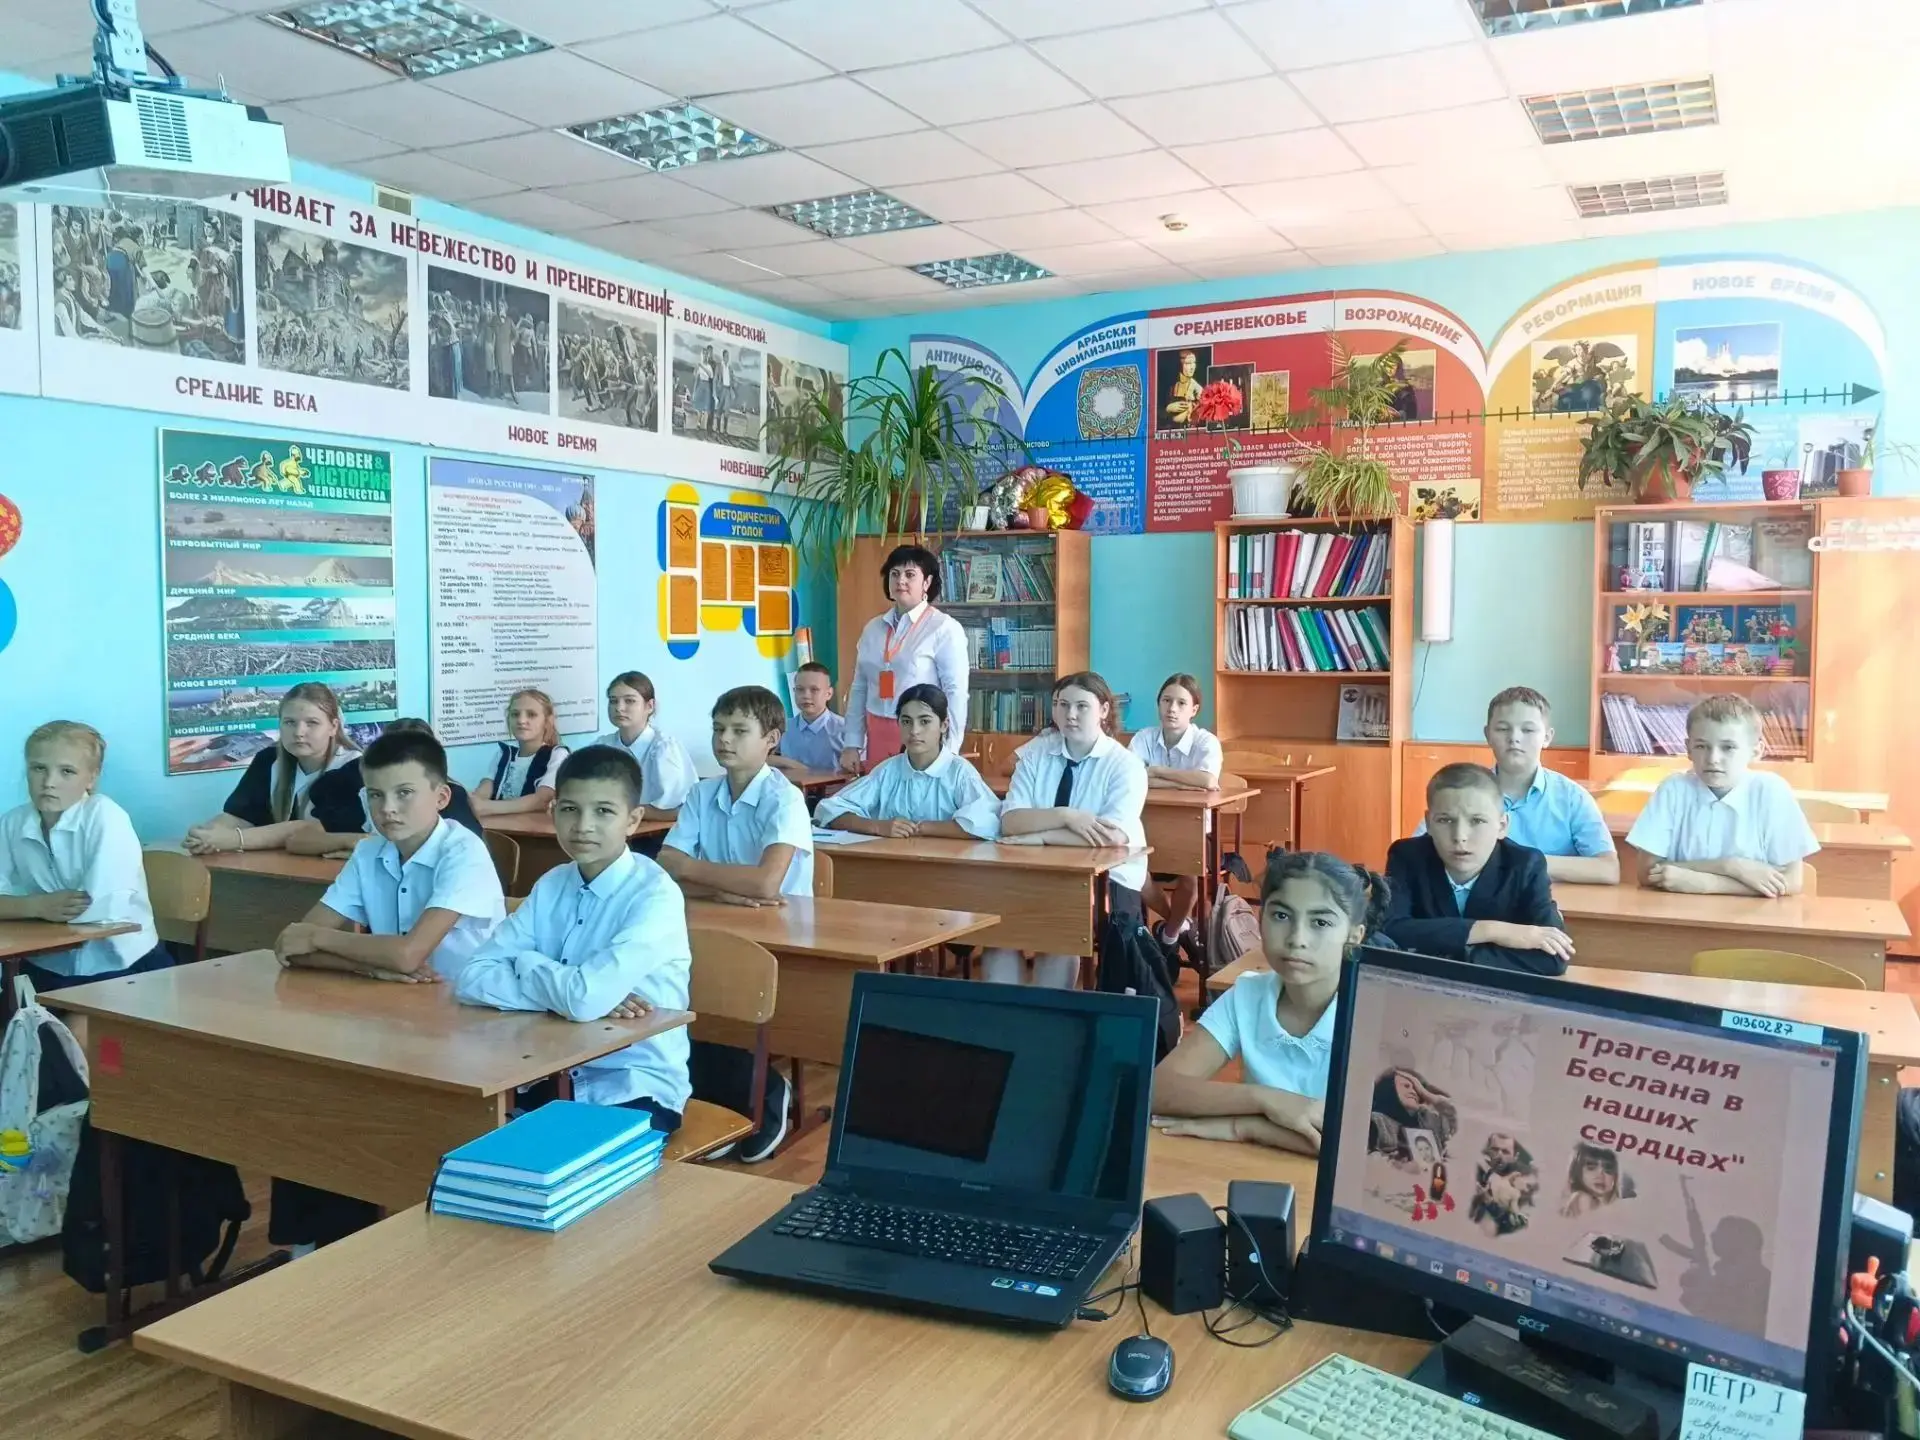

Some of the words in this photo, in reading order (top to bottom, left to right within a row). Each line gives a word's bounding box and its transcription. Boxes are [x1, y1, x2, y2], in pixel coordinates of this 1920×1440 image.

[350, 209, 377, 239] ЗА
[391, 221, 516, 275] НЕВЕЖЕСТВО
[526, 259, 538, 281] И
[1692, 276, 1756, 291] НОВОЕ
[1770, 278, 1838, 303] ВРЕМЯ
[1521, 283, 1643, 335] РЕФОРМАЦИЯ
[1174, 310, 1307, 336] СРЕДНЕВЕКОВЬЕ
[1345, 308, 1464, 345] ВОЗРОЖДЕНИЕ
[1077, 325, 1136, 350] АРАБСКАЯ
[926, 348, 1004, 386] АНТИЧНОСТЬ
[1055, 337, 1136, 377] ЦИВИЛИЗАЦИЯ
[175, 376, 264, 406] СРЕДНИЕ
[273, 389, 318, 413] ВЕКА
[508, 425, 549, 447] НОВОЕ
[557, 432, 597, 452] ВРЕМЯ
[1384, 442, 1434, 451] способности
[305, 447, 373, 469] ЧЕЛОВЕК
[720, 459, 770, 480] НОВЕЙШЕЕ
[314, 467, 390, 490] ИСТОРИЯ
[169, 491, 200, 500] БОЛЕЕ
[210, 494, 267, 504] МИЛЛИОНОВ
[268, 498, 285, 506] ЛЕТ
[287, 499, 313, 508] НАЗАД
[308, 484, 386, 500] ЧЕЛОВЕЧЕСТВА
[713, 508, 780, 525] МЕТОДИЧЕСКИЙ
[731, 524, 763, 537] УГОЛОК
[169, 539, 240, 549] ПЕРВОБЫТНЫЙ
[242, 542, 261, 550] МИР
[170, 586, 214, 595] ДРЕВНИЙ
[173, 633, 215, 641] СРЕДНИЕ
[217, 632, 240, 640] ВЕКА
[173, 680, 205, 688] НОВОЕ
[207, 679, 237, 687] ВРЕМЯ
[174, 724, 225, 734] НОВЕЙШЕЕ
[228, 723, 257, 731] ВРЕМЯ
[1732, 1015, 1793, 1035] 01360287
[1561, 1023, 1741, 1081] "Трагедия
[1565, 1058, 1710, 1107] Беслана
[1724, 1093, 1744, 1113] в
[1583, 1092, 1699, 1135] наших
[1579, 1123, 1746, 1173] сердцах"
[1517, 1315, 1550, 1332] acer
